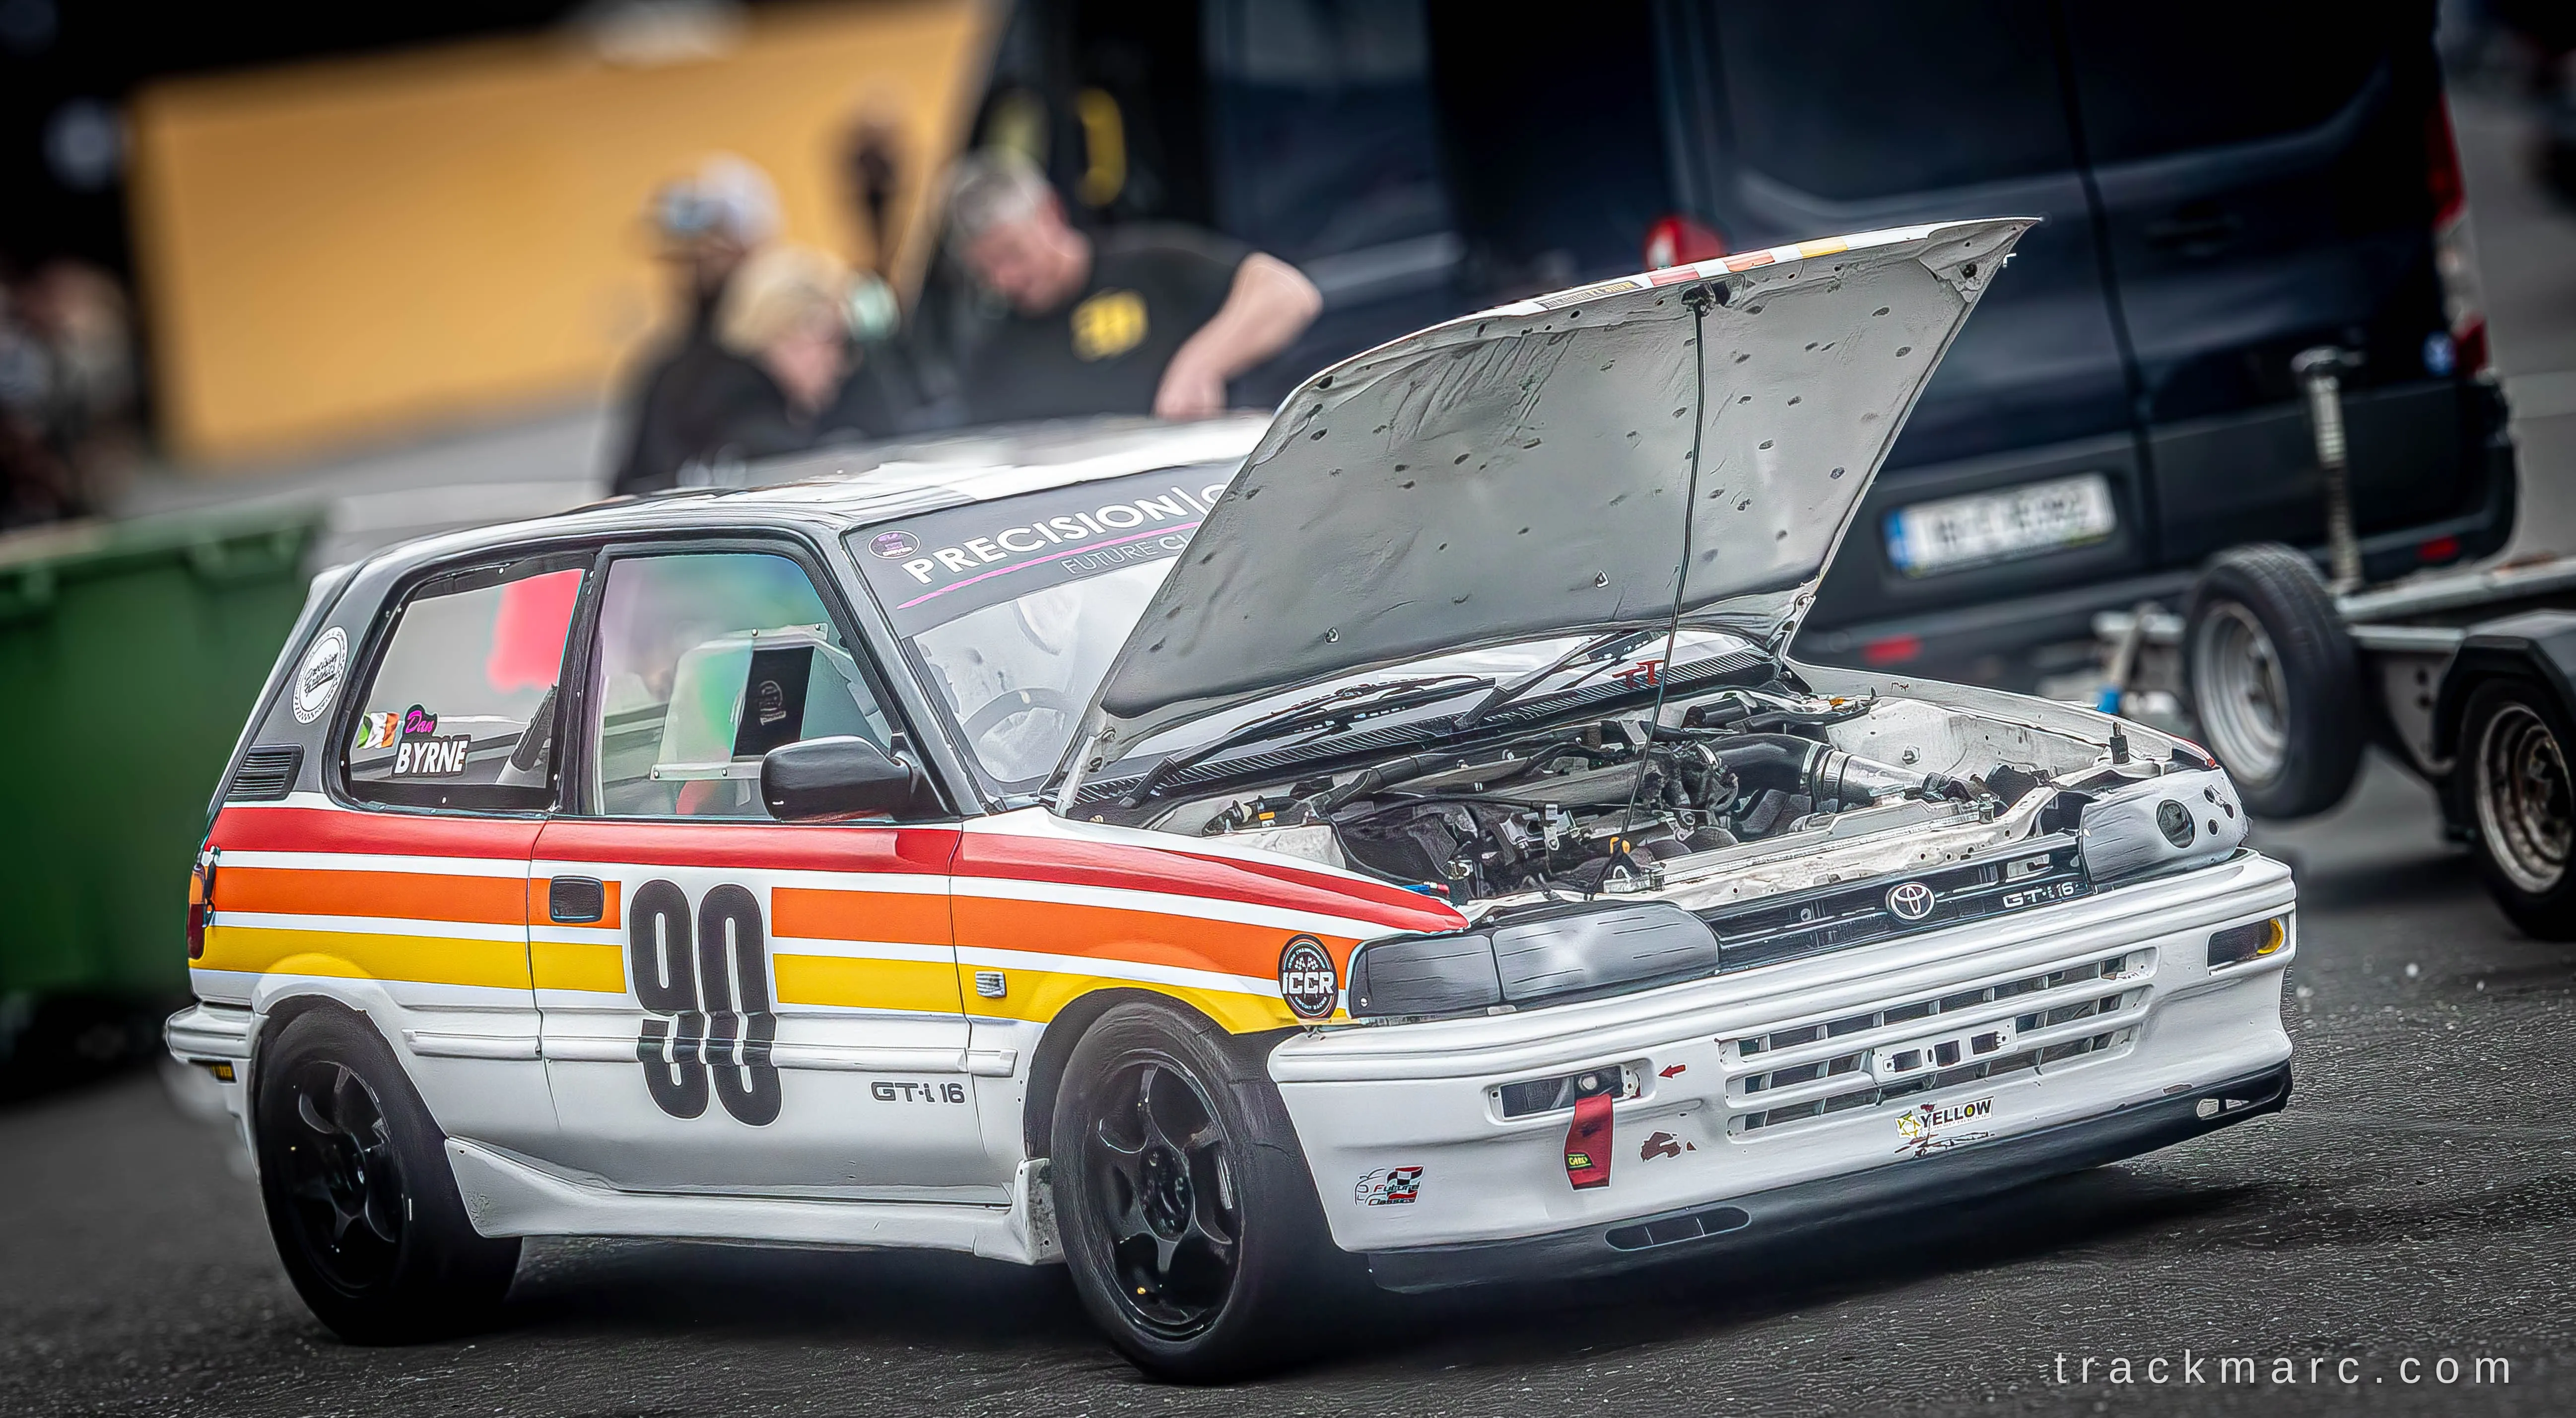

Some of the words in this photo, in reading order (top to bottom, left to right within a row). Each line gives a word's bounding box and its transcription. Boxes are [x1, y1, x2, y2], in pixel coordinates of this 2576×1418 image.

[1061, 541, 1158, 574] FUTURE
[405, 710, 435, 733] Dan
[394, 740, 469, 774] BYRNE
[1282, 971, 1334, 994] ICCR
[629, 879, 782, 1127] 90
[1920, 1099, 1992, 1128] YELLOW
